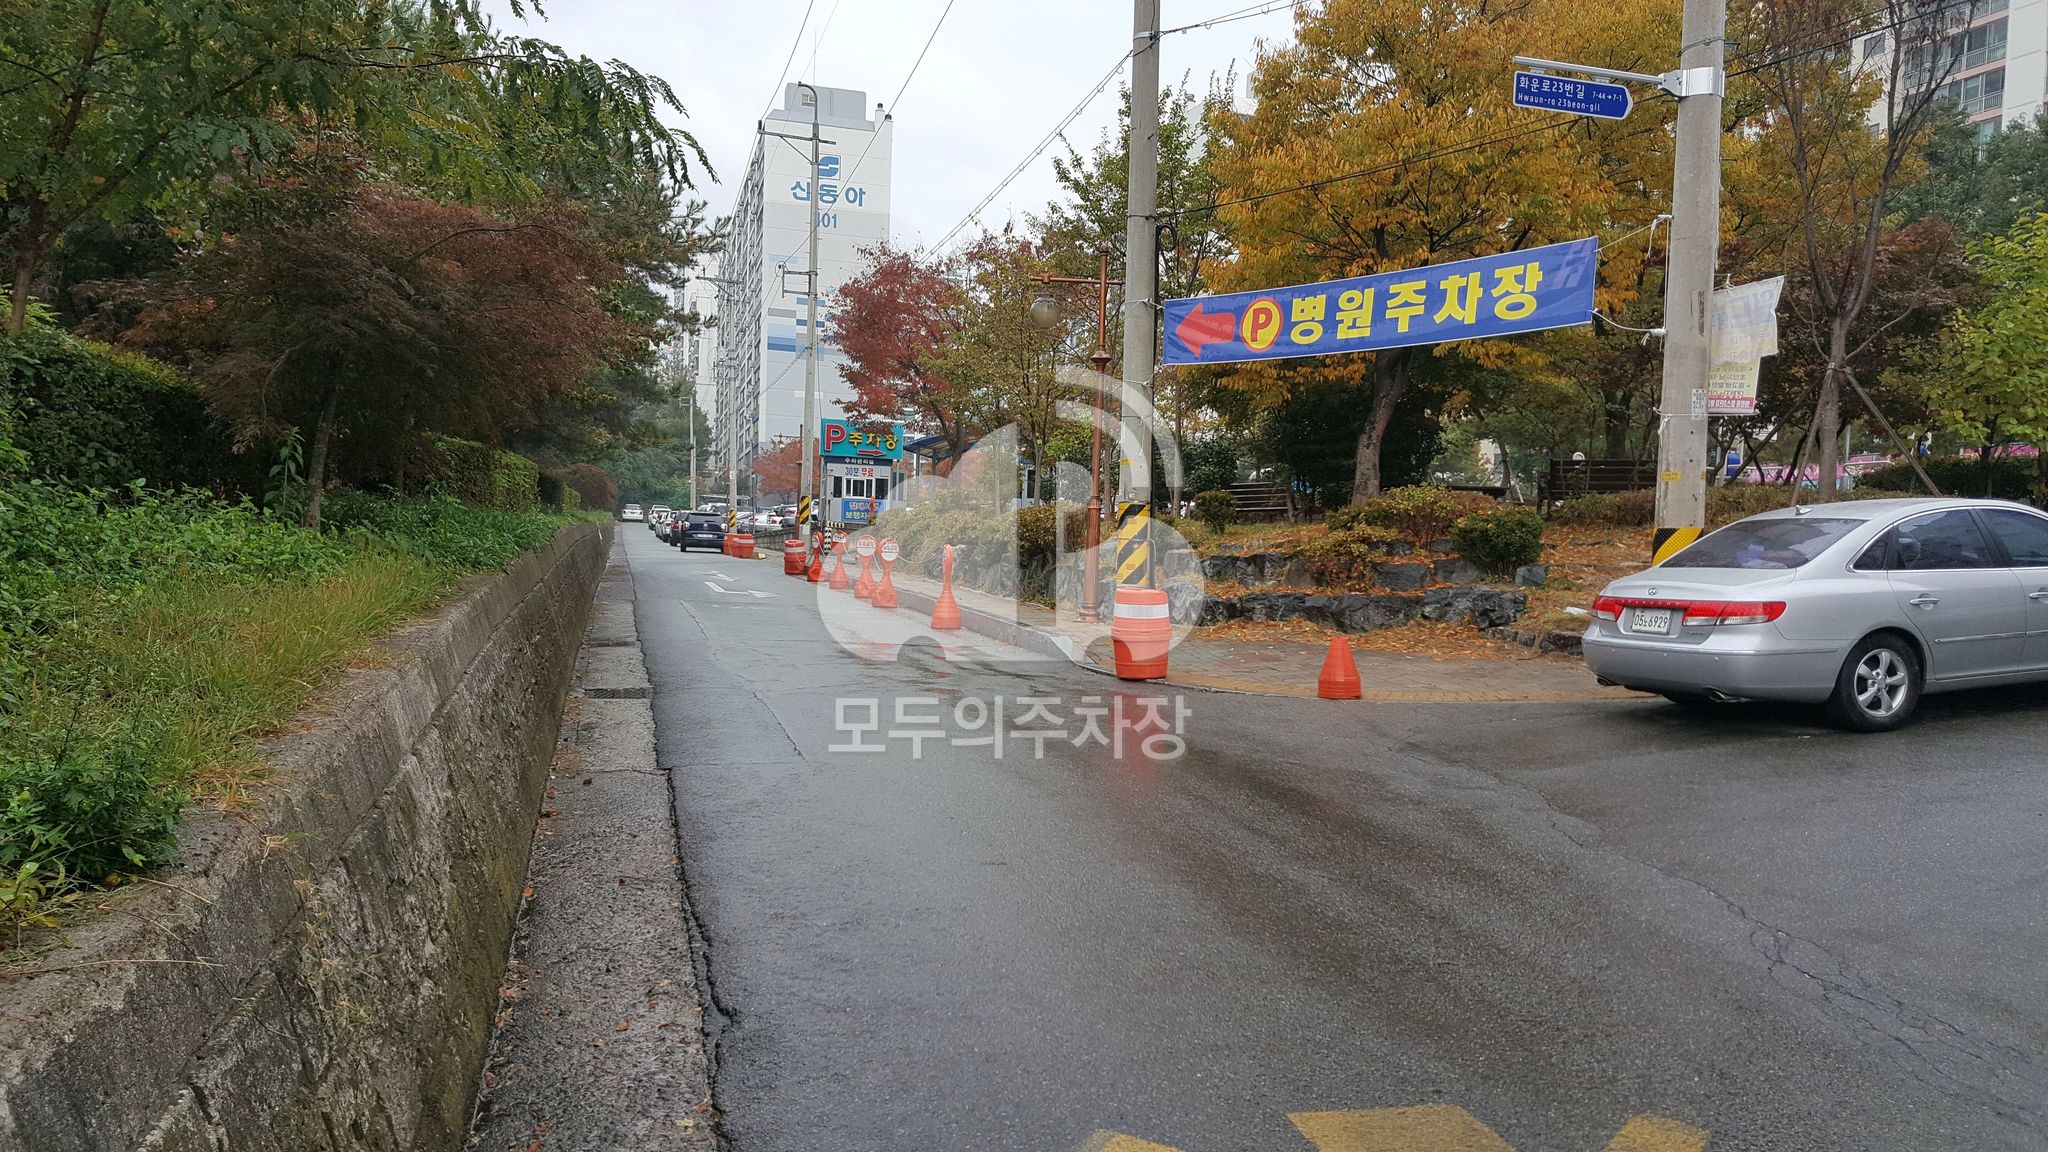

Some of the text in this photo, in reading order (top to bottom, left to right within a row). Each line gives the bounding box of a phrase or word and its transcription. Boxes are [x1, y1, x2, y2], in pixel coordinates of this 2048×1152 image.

[1519, 76, 1585, 99] 화운로23번길
[1518, 93, 1600, 112] Hwaun-ro 23beon-gil
[790, 181, 866, 207] 신동아
[1250, 261, 1543, 346] P 병원주차장
[825, 424, 846, 451] P
[861, 467, 874, 477] 무료
